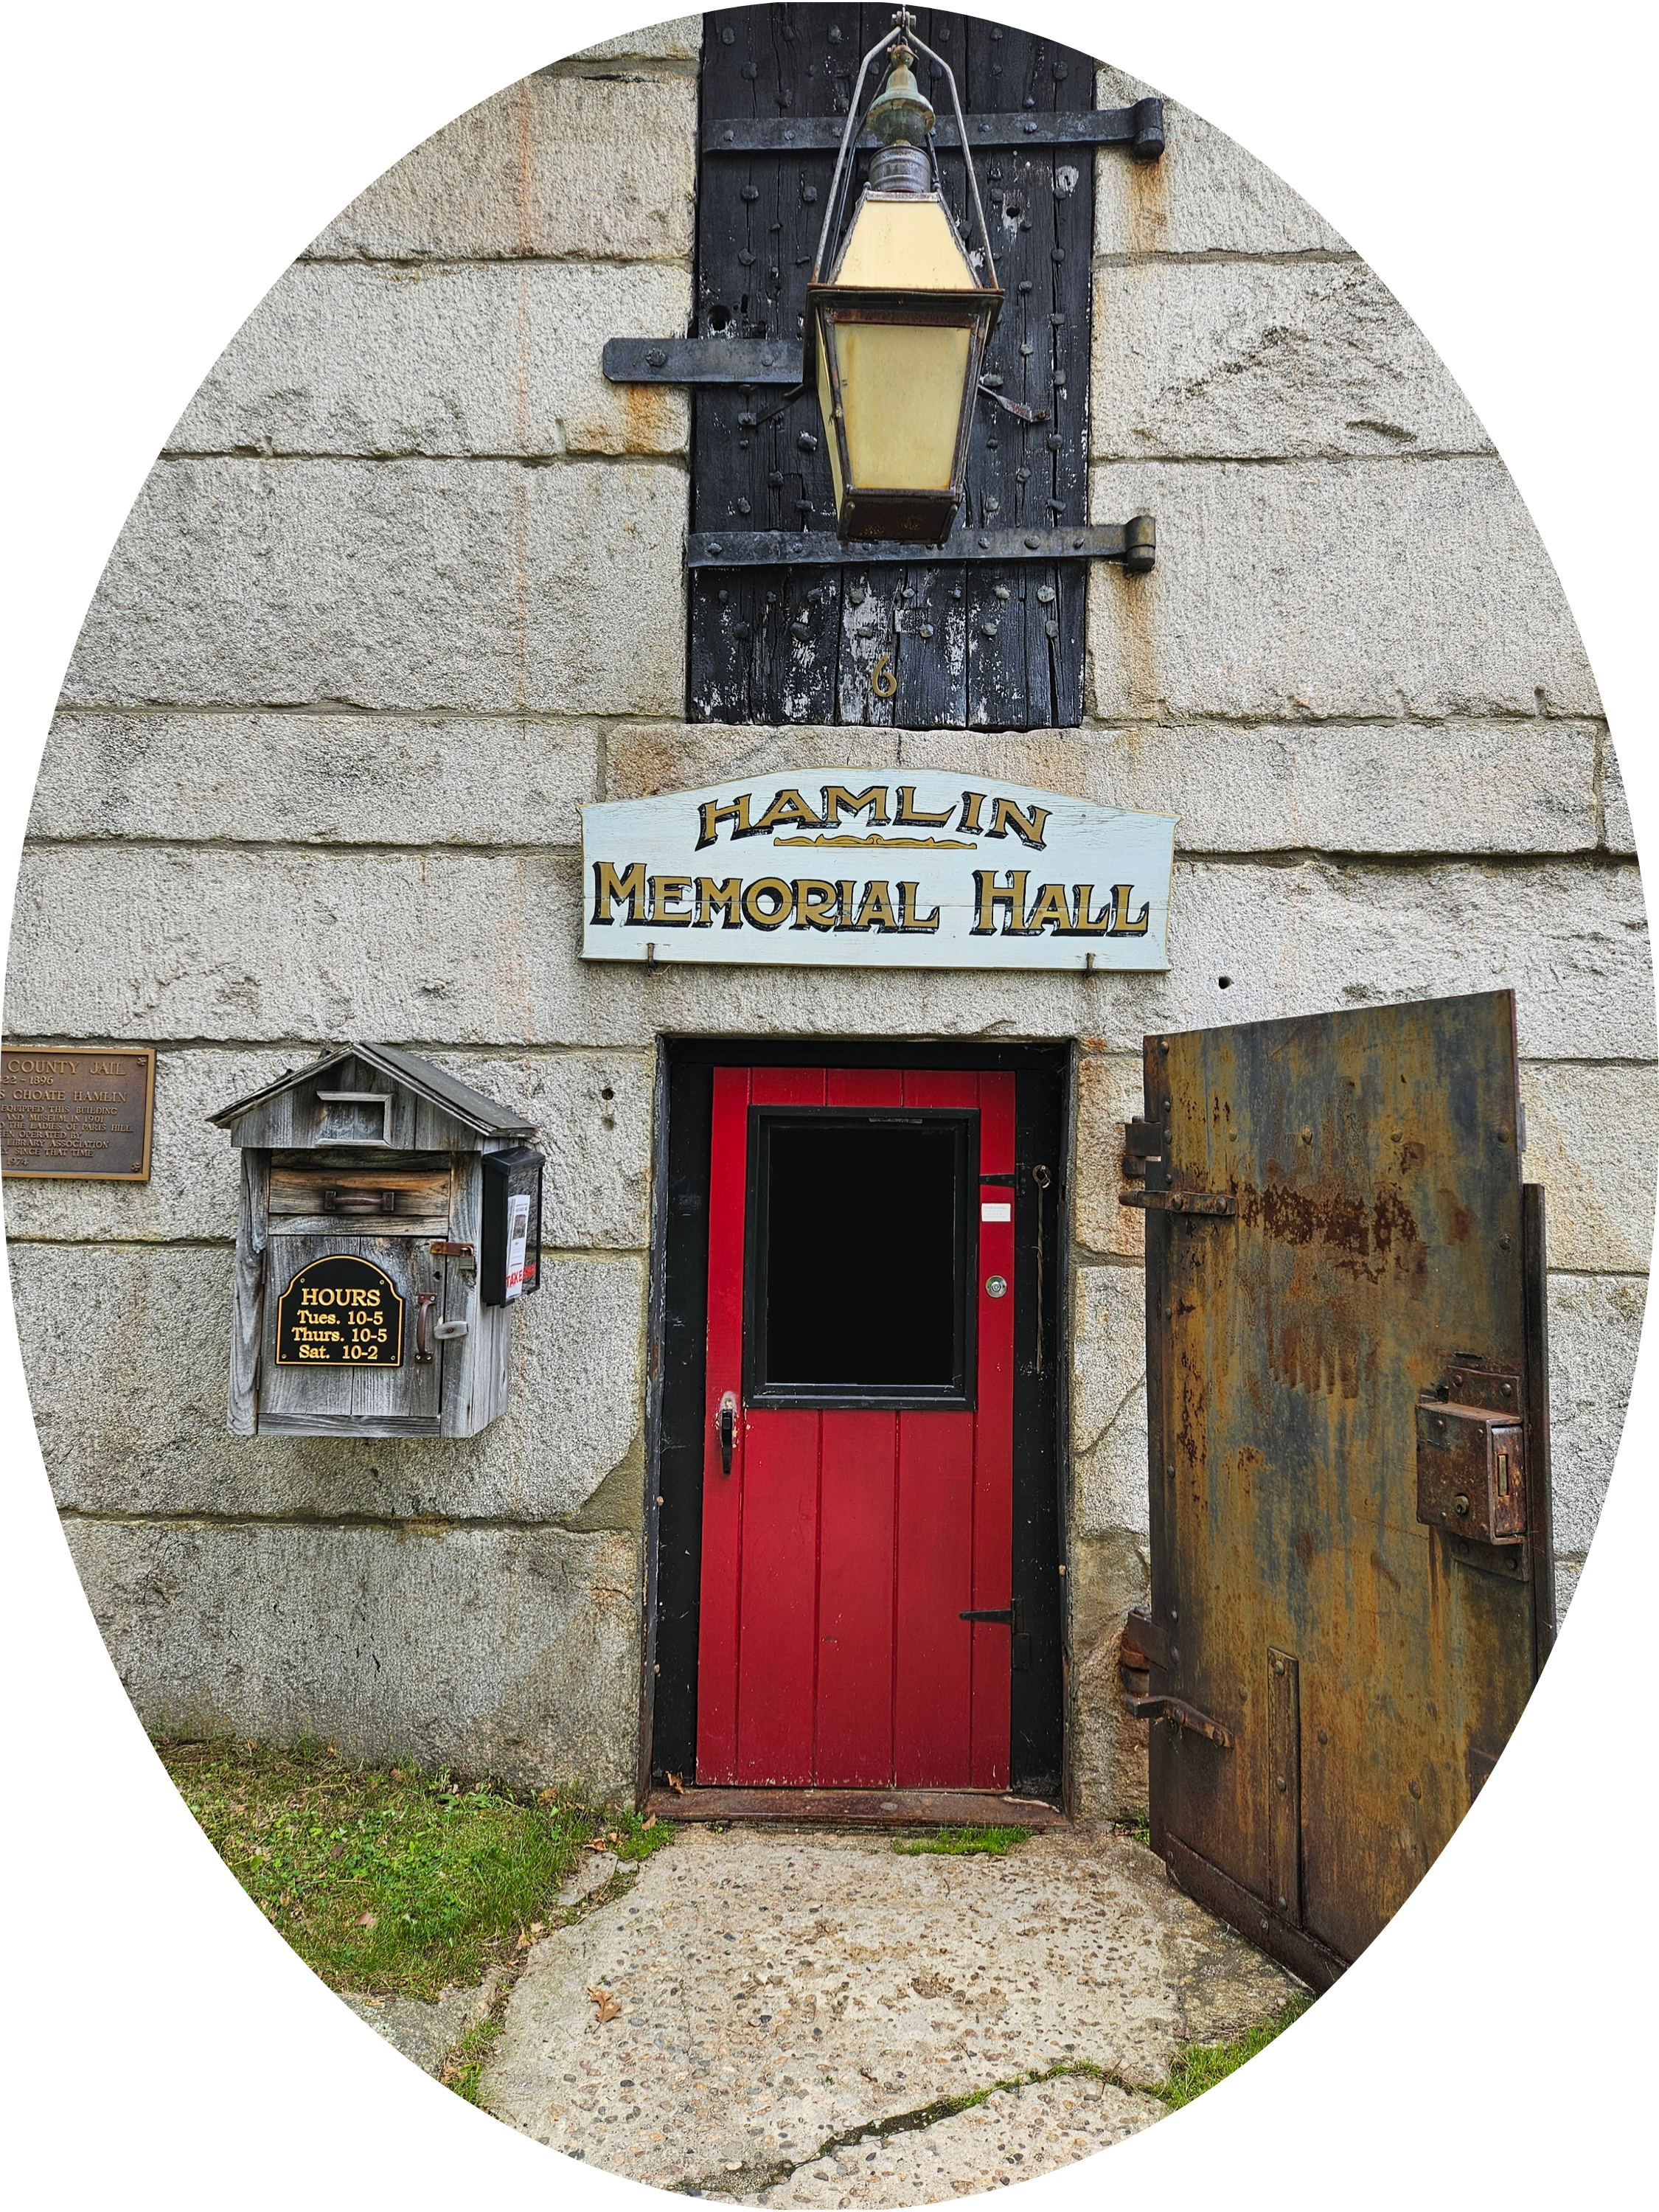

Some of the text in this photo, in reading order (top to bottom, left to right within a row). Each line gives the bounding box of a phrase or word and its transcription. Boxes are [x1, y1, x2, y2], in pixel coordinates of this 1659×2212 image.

[872, 654, 897, 698] 6
[695, 785, 1054, 852] HAMLIN
[589, 860, 1150, 938] MEMORIAL HALL
[7, 1060, 125, 1076] COUNTY JAIL
[29, 1076, 54, 1085] 1896
[13, 1089, 66, 1102] CHOATE
[73, 1091, 127, 1102] HAMLIN
[1, 1105, 45, 1113] EQUIPPED
[76, 1107, 118, 1115] BUILDING
[5, 1113, 24, 1121] AND
[29, 1114, 69, 1122] MUSEUM
[30, 1122, 63, 1130] LADIES
[19, 1131, 67, 1139] OPERATED
[7, 1139, 45, 1147] LIBRARY
[49, 1140, 109, 1149] ASSOCIATION
[72, 1150, 94, 1158] TIME
[7, 1157, 29, 1166] 1974
[505, 1269, 523, 1288] TAKE
[301, 1288, 380, 1306] HOURS
[296, 1309, 383, 1325] Tues. 10-5
[291, 1326, 387, 1343] Thurs. 10-5
[299, 1344, 378, 1360] Sat. 10-2
